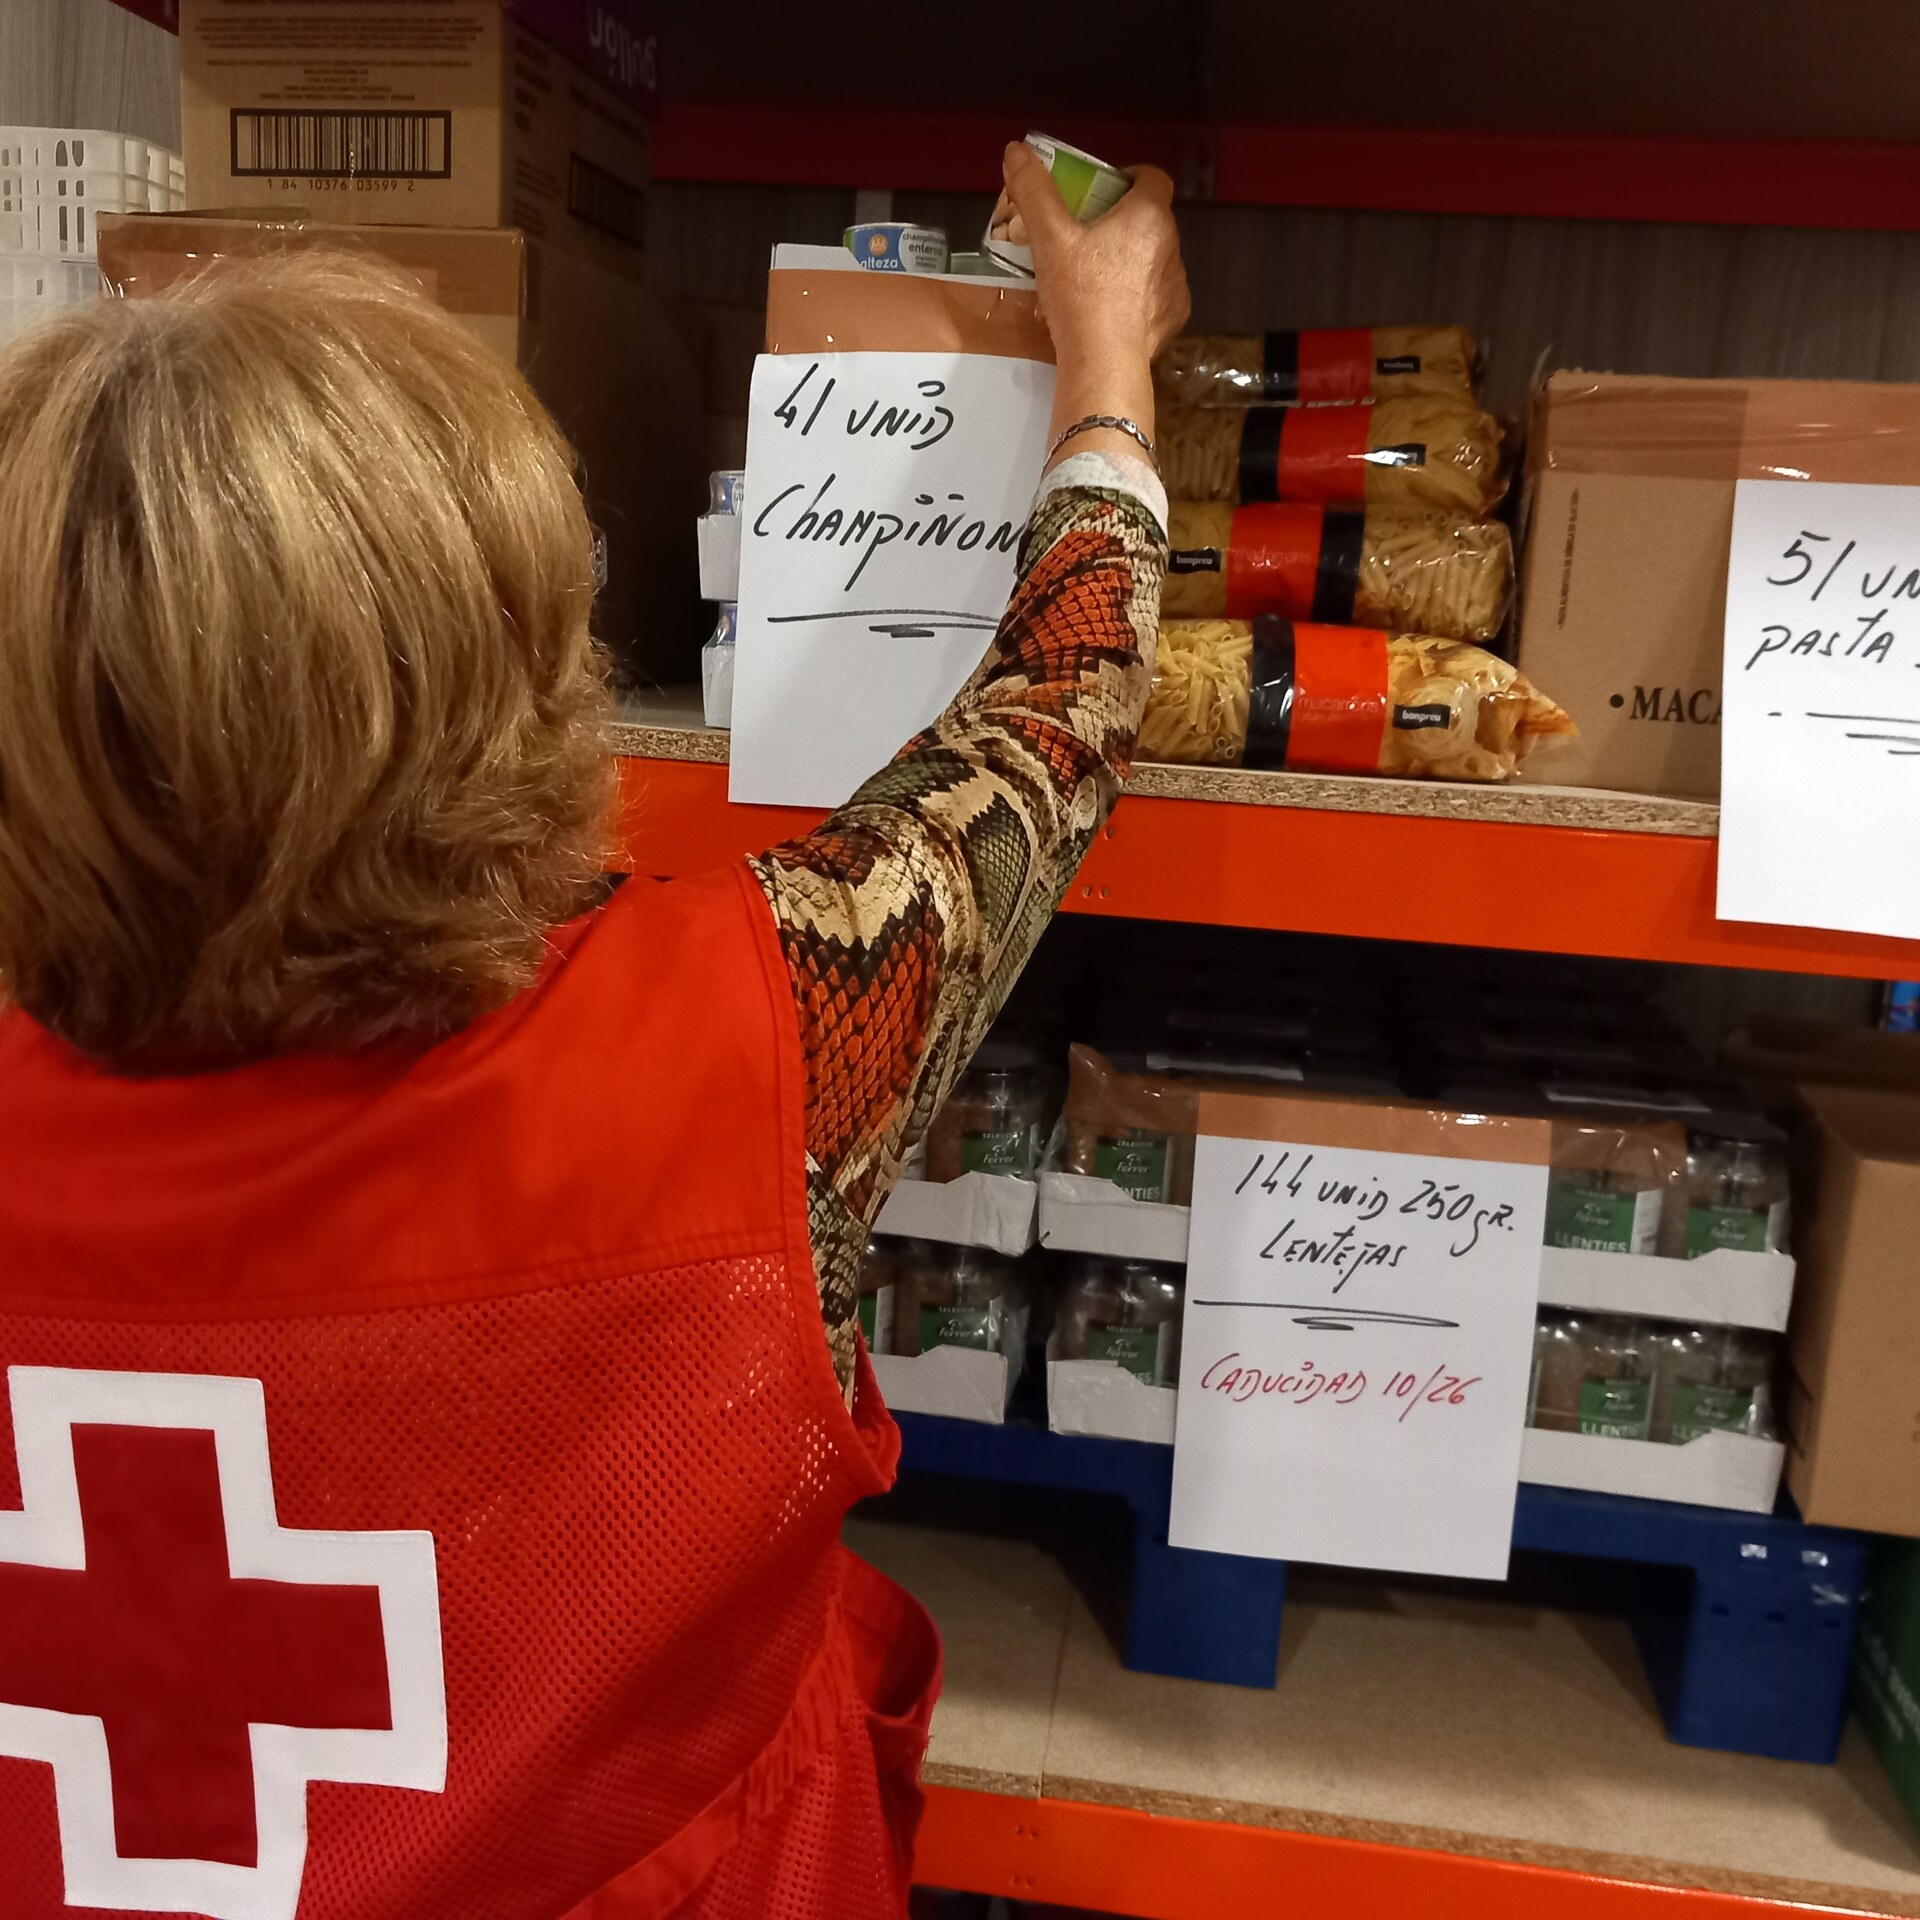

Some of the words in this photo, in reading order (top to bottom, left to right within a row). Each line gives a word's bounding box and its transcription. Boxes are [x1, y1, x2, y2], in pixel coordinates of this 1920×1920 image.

[266, 179, 273, 190] 1
[282, 179, 297, 190] 84
[308, 179, 347, 191] 10376
[356, 179, 398, 192] 03599
[407, 180, 415, 192] 2
[860, 256, 898, 269] alteza
[1402, 709, 1442, 722] bonpreu
[1234, 1151, 1314, 1197] 144
[1120, 1186, 1160, 1200] NTIES
